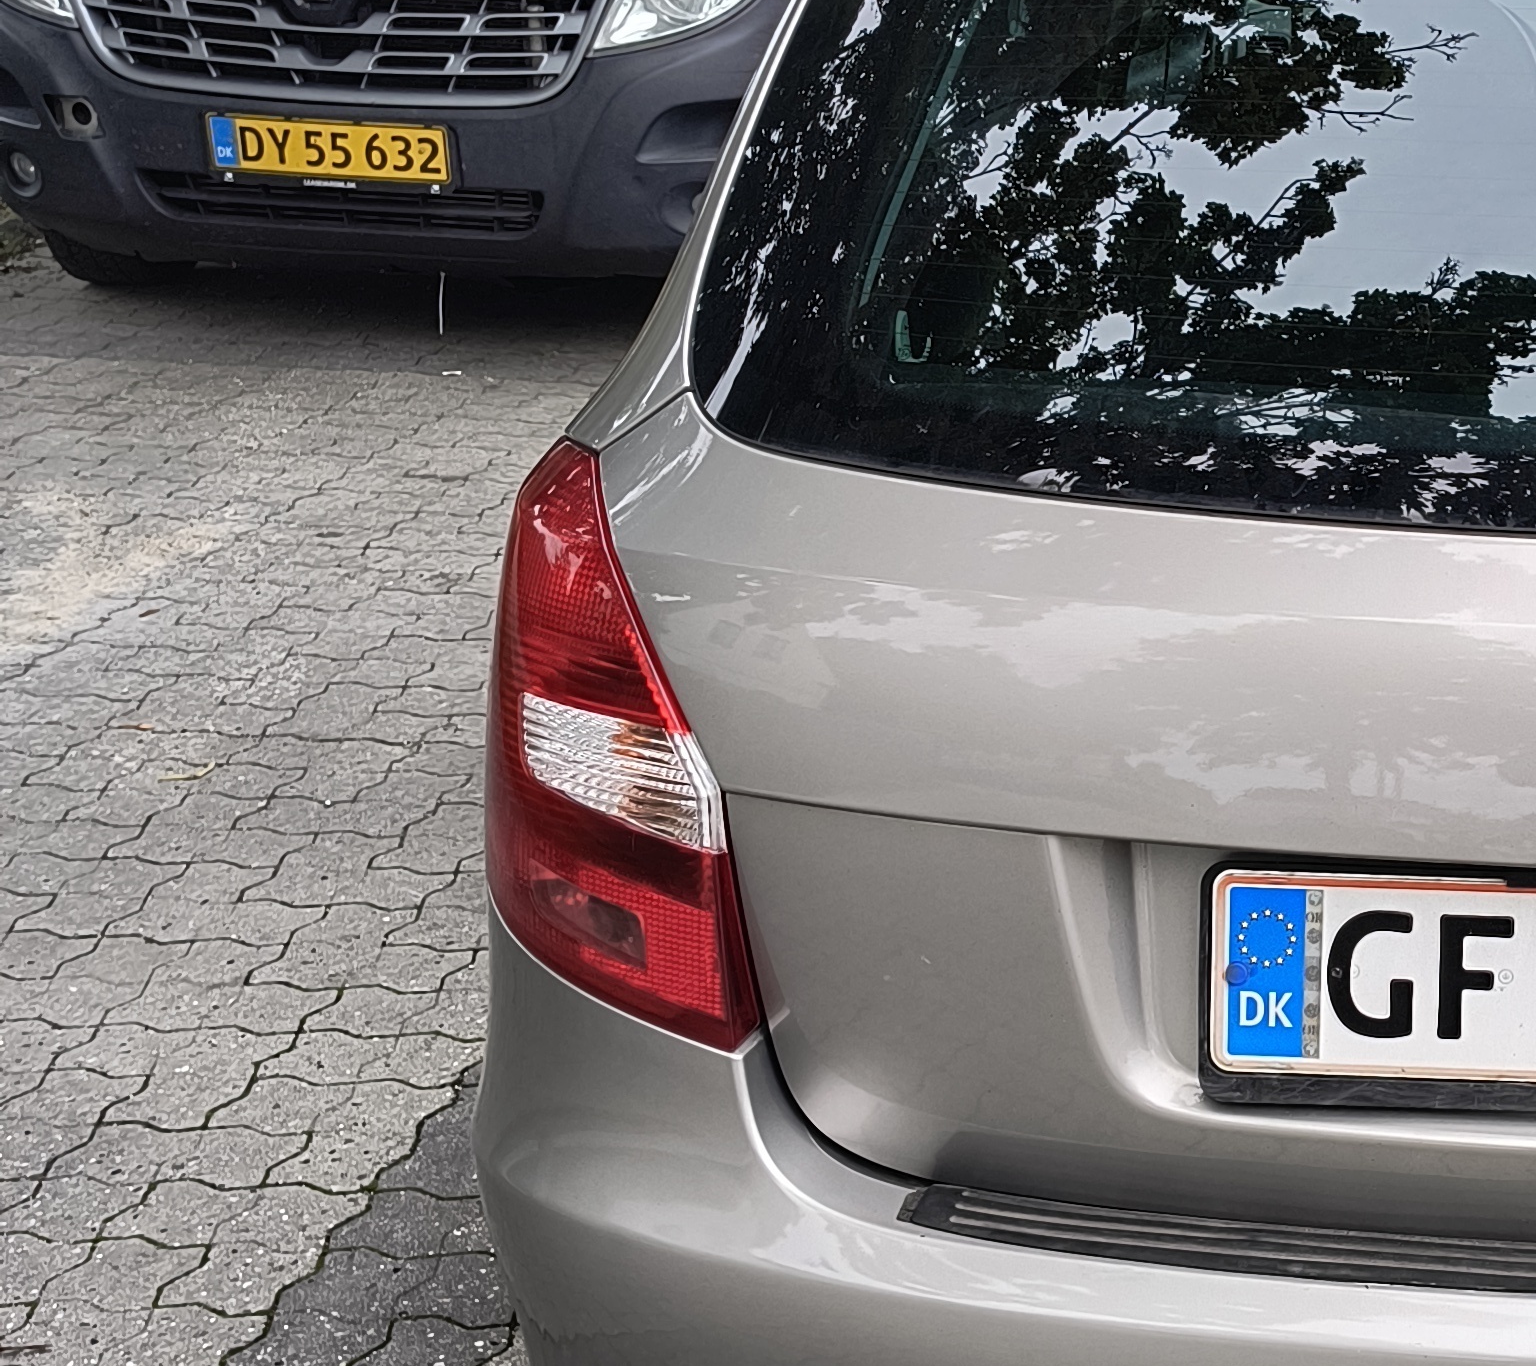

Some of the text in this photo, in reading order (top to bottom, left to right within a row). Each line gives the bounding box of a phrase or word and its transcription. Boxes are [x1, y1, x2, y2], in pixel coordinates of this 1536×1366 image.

[217, 146, 234, 159] DK
[238, 125, 442, 175] DY 55 632
[1326, 909, 1516, 1041] GF
[1238, 989, 1294, 1028] DK
